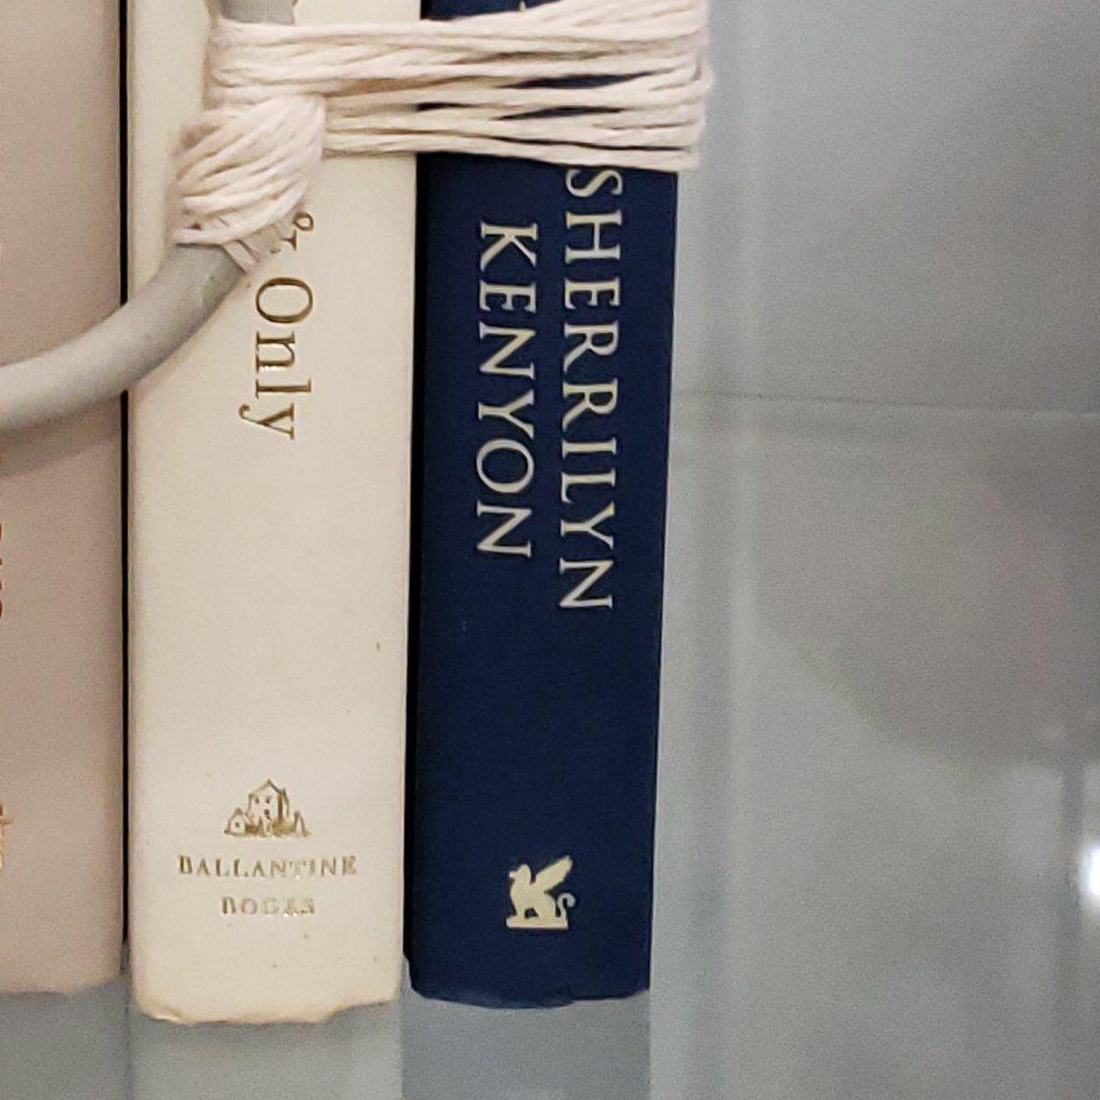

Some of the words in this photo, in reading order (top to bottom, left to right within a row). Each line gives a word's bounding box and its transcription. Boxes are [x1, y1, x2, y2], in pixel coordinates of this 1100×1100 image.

[238, 276, 314, 440] Only
[475, 221, 538, 559] KENYON
[559, 169, 624, 610] SHERRILYN
[177, 854, 358, 879] BALLANTINE
